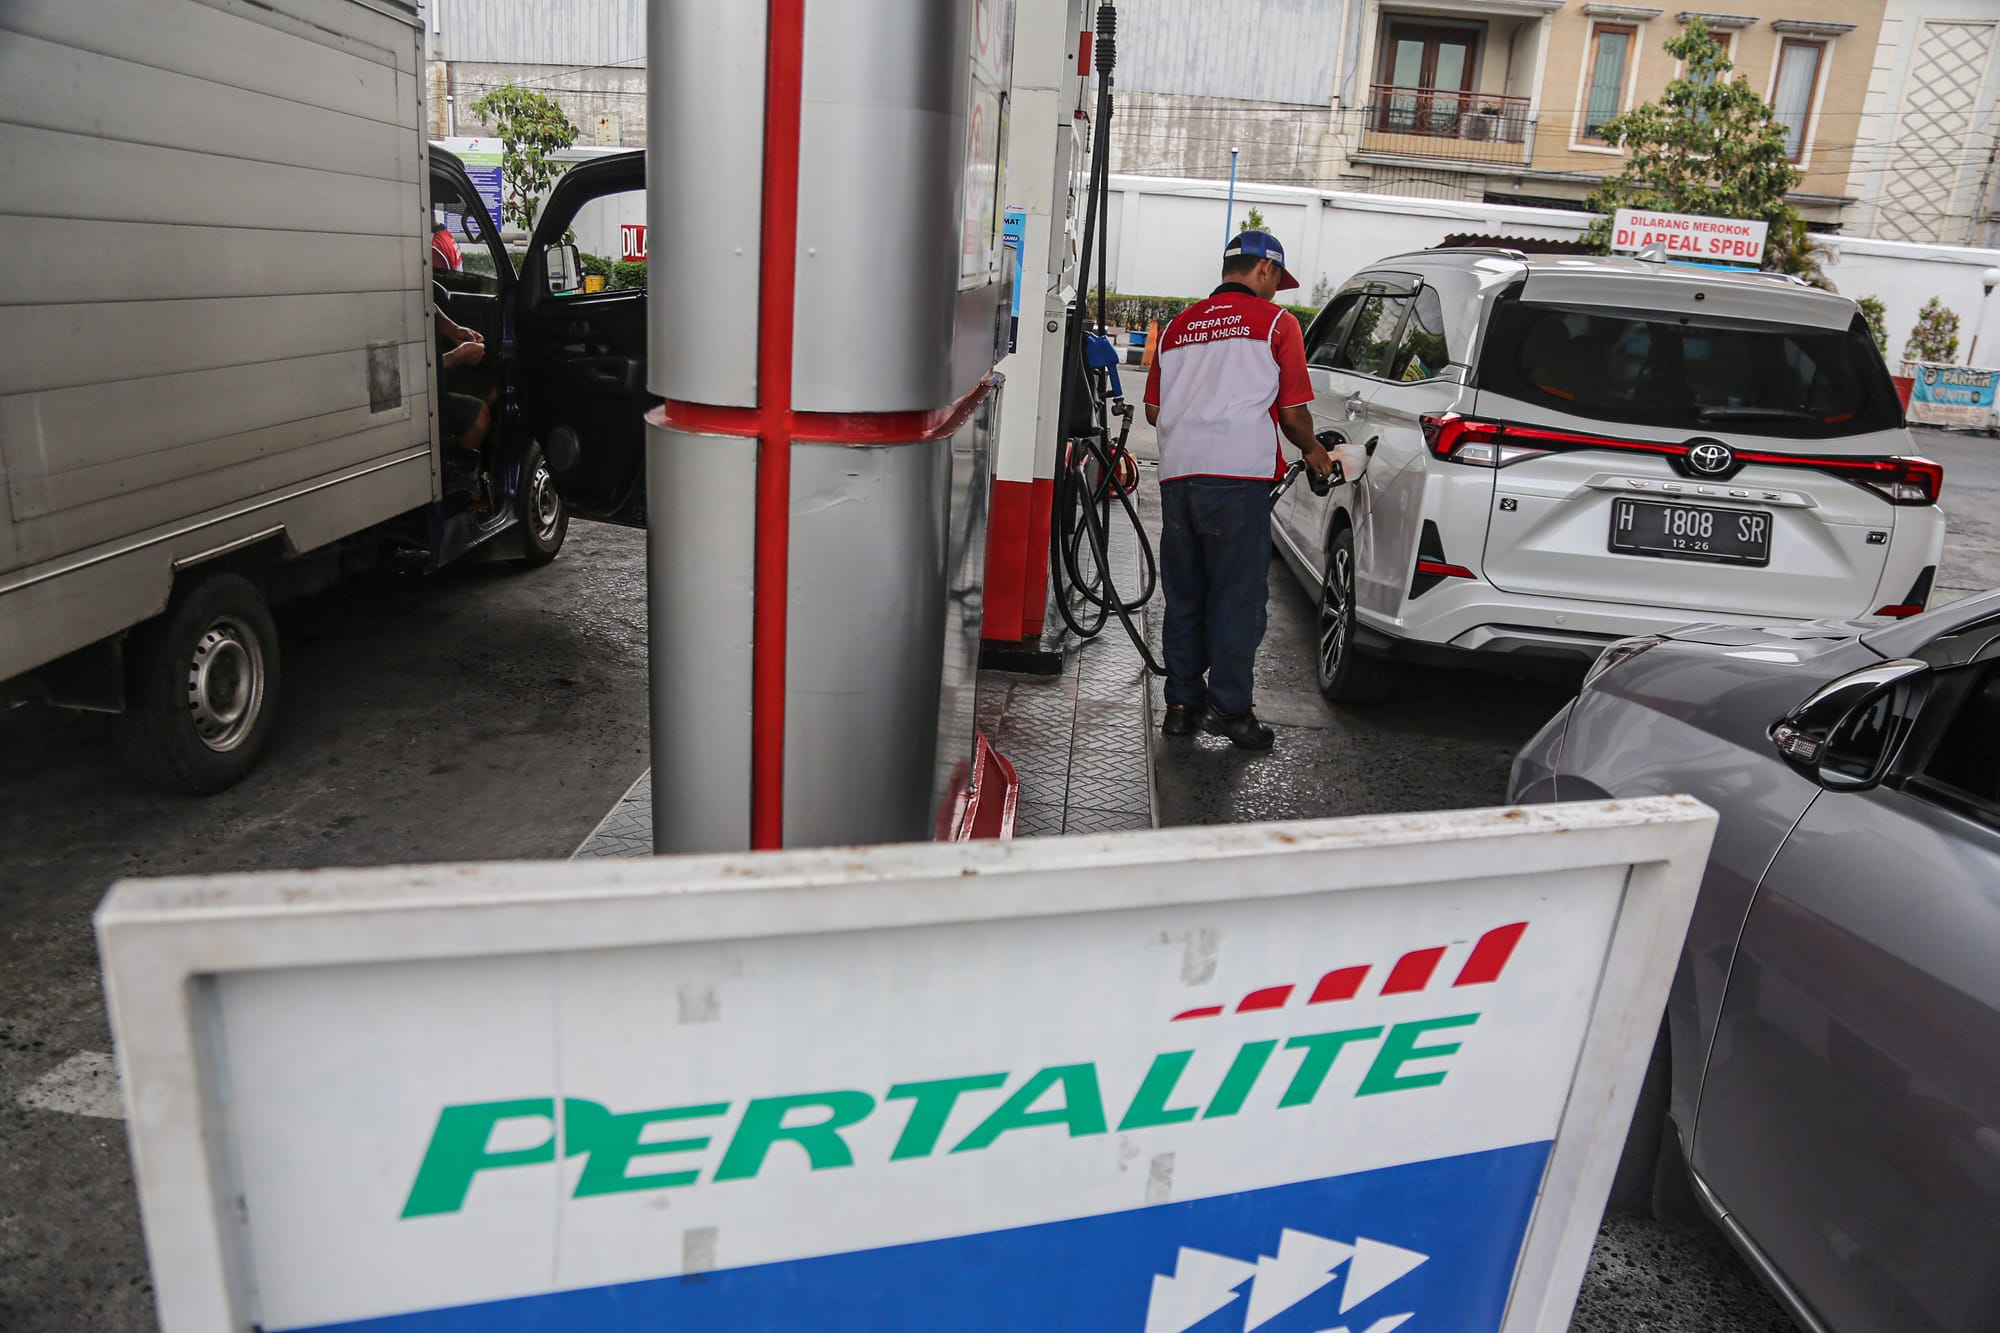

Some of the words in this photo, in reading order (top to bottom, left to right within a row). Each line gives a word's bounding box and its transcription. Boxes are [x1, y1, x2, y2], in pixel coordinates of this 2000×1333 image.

[1630, 216, 1690, 230] DILARANG
[1693, 222, 1750, 236] MEROKOK
[1616, 229, 1635, 246] DI
[1708, 239, 1760, 257] SPBU
[1187, 315, 1242, 330] OPERATOR
[1175, 332, 1208, 345] JALUR
[1211, 326, 1250, 339] KHUSUS
[1941, 371, 1991, 387] PARKIR
[1619, 504, 1634, 531] H
[1663, 508, 1713, 538] 1808
[1737, 516, 1765, 543] SR
[399, 1012, 1482, 1221] PERTALITE
